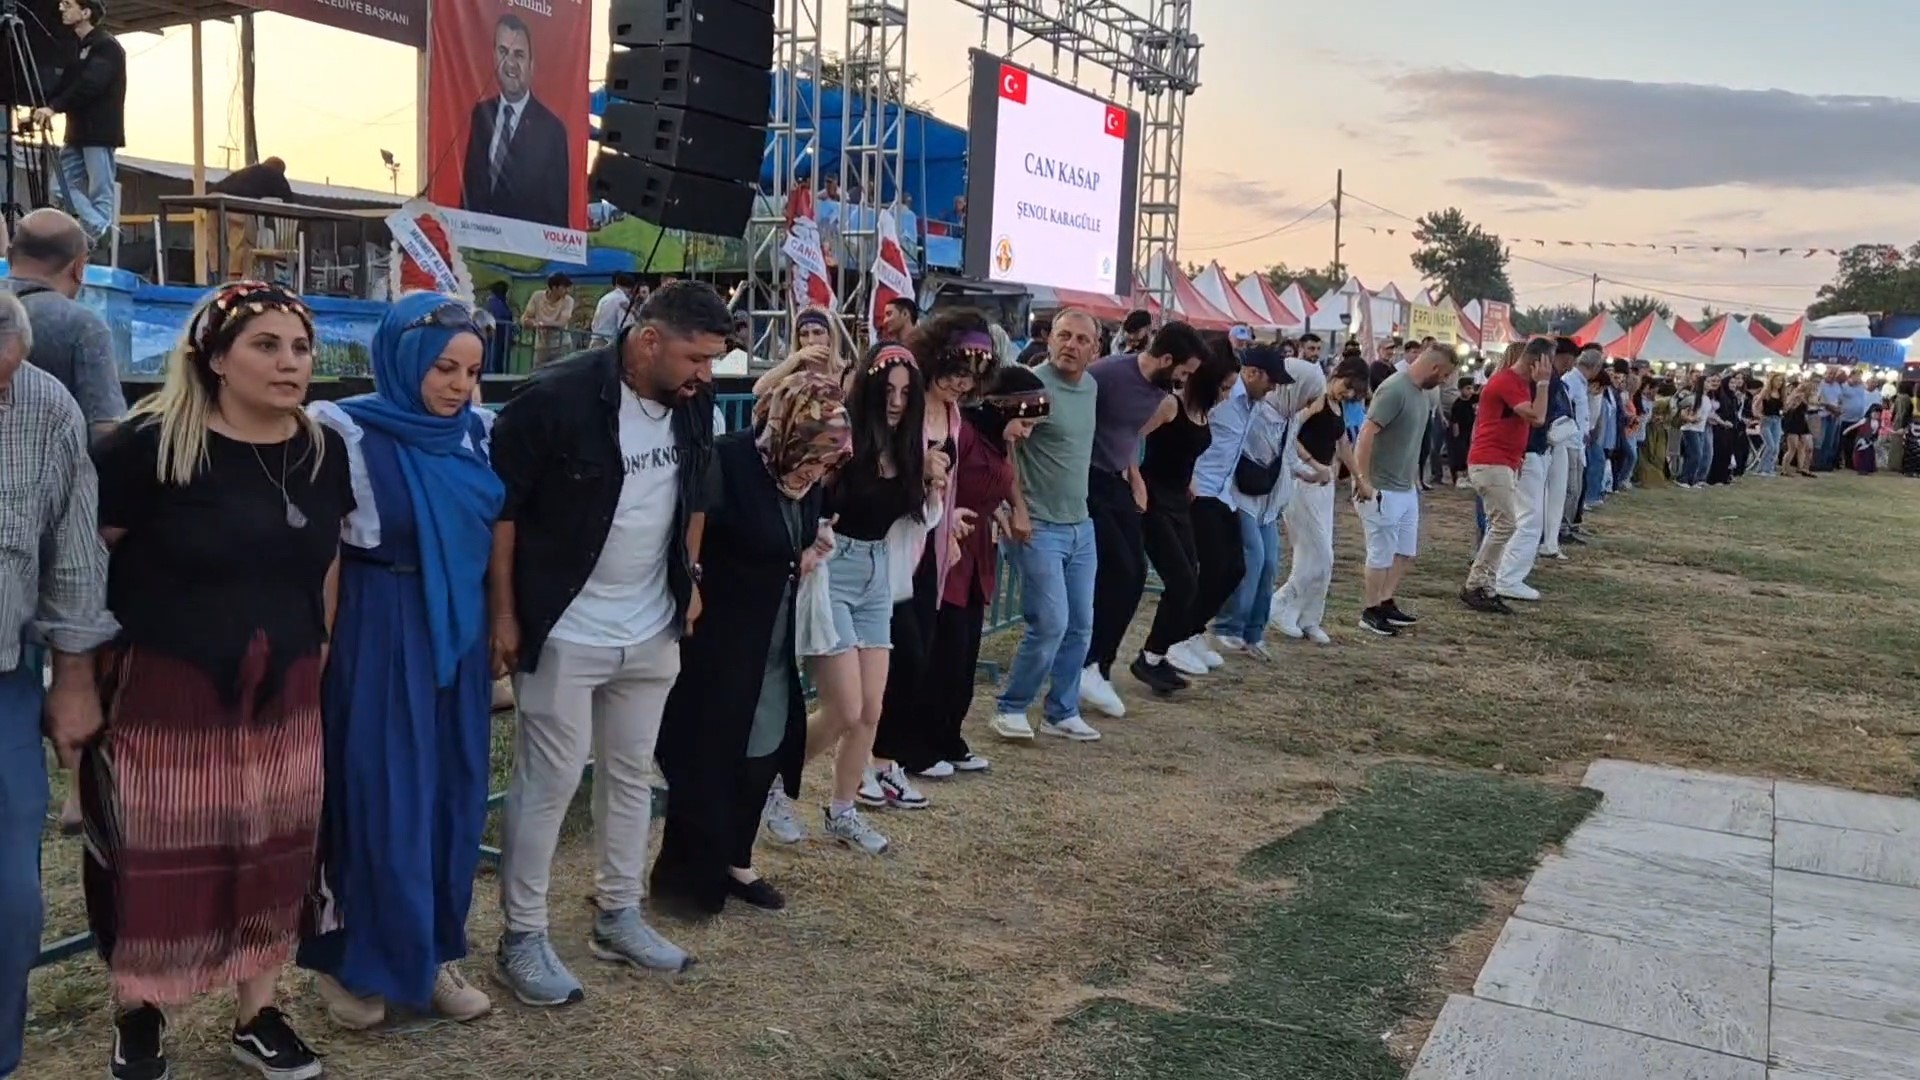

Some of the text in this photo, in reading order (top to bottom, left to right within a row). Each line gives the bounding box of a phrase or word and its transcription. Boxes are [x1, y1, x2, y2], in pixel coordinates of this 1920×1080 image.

[364, 3, 409, 26] BAŞKANI
[1024, 152, 1101, 192] CAN KASAP
[1017, 200, 1101, 233] ŞENOL KARAGÜLLE
[409, 228, 437, 259] MEHMET
[542, 229, 582, 247] VOLKAN
